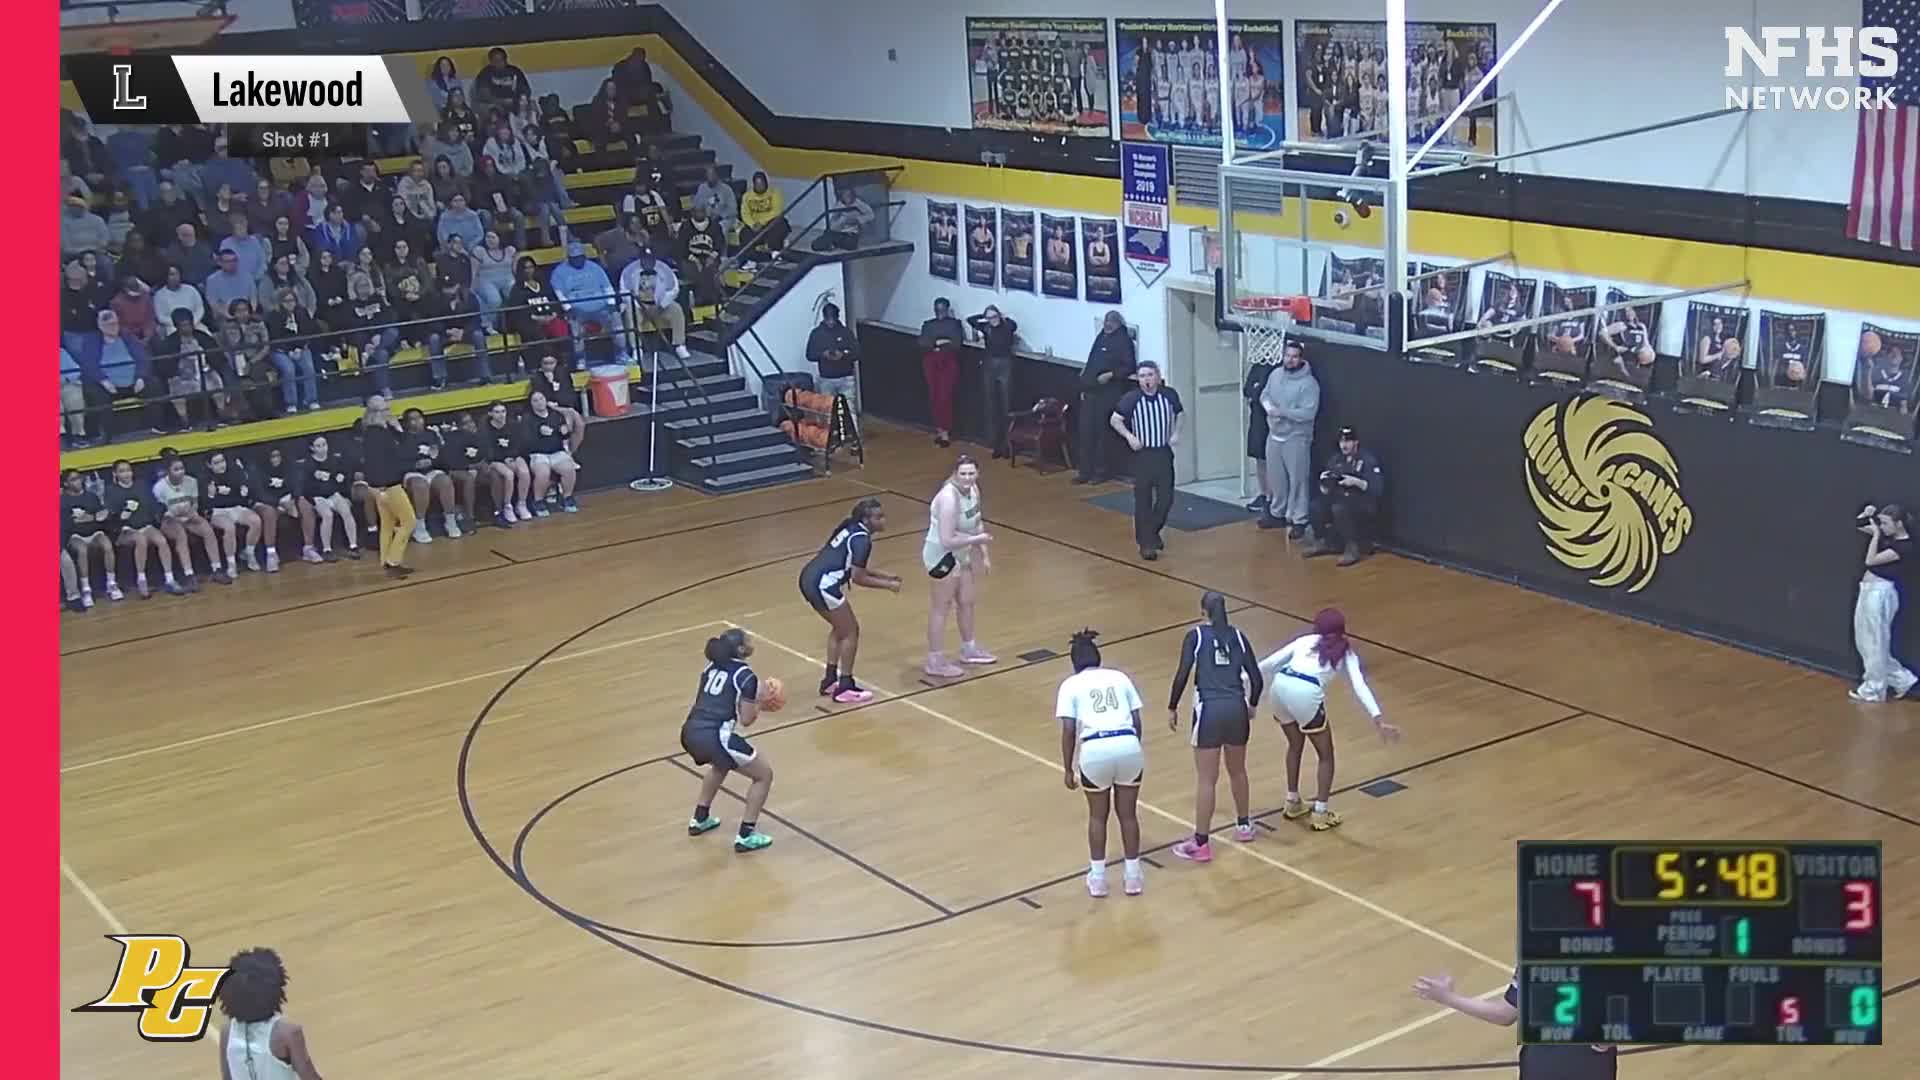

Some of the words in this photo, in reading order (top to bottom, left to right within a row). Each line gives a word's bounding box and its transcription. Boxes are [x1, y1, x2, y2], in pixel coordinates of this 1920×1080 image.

[1136, 180, 1155, 193] 2019
[704, 669, 728, 696] 10
[1090, 687, 1119, 713] 24
